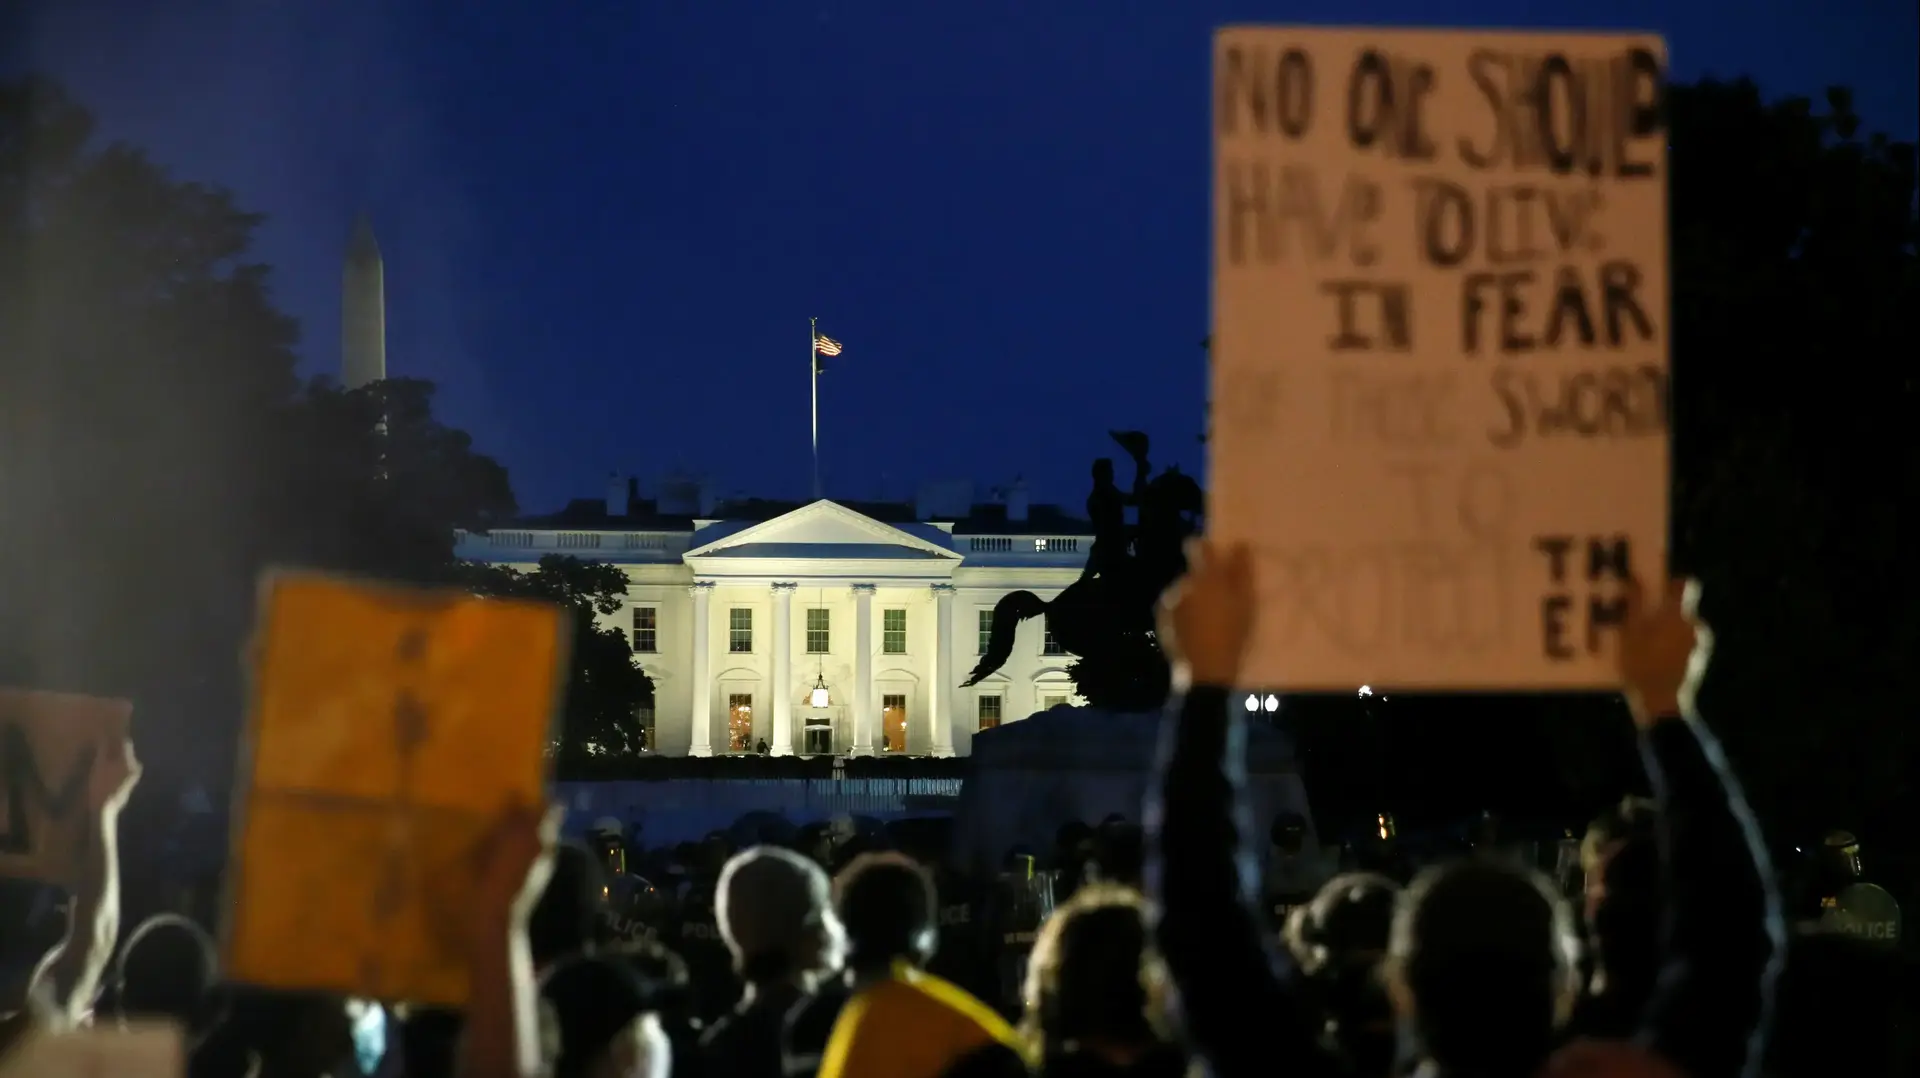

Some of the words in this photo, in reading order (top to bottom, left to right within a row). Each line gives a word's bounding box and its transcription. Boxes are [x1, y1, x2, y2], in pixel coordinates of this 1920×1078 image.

[1219, 45, 1315, 140] NO
[1317, 277, 1413, 353] IN
[1460, 258, 1658, 357] FEAR
[681, 920, 721, 940] POL
[1836, 919, 1896, 940] OLICE
